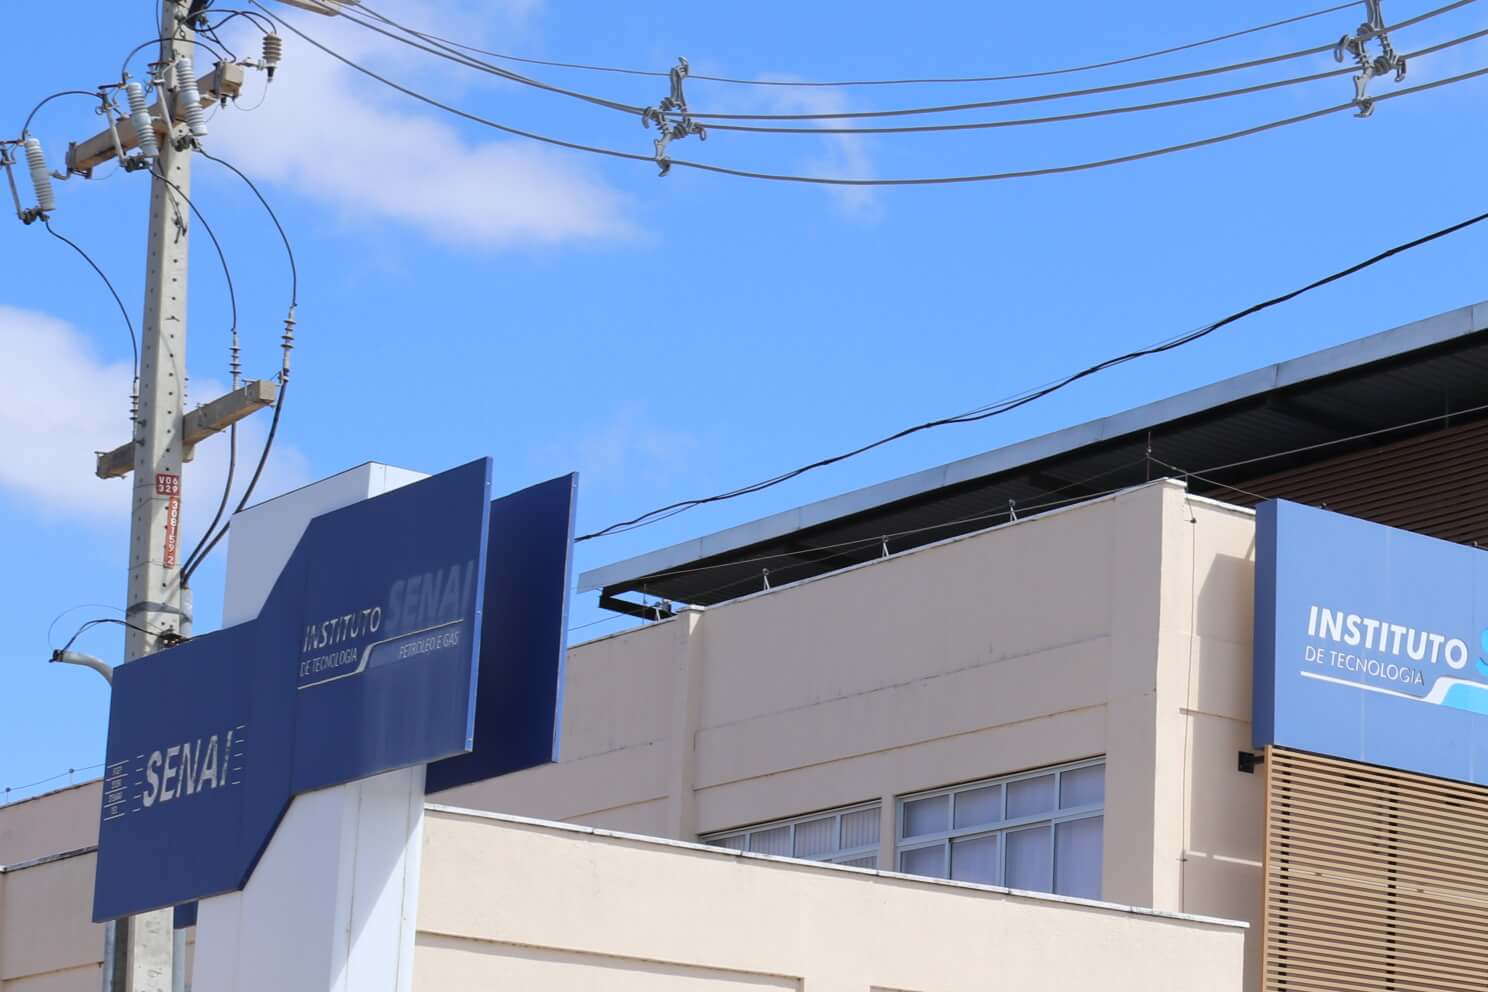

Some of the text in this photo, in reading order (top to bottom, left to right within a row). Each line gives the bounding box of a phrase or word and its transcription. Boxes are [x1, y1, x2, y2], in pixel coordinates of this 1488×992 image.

[303, 560, 474, 653] INSTITUTO SENAI
[1307, 605, 1468, 670] INSTITUTO
[1304, 645, 1425, 686] DE TECNOLOGIA
[143, 730, 233, 807] SENAI
